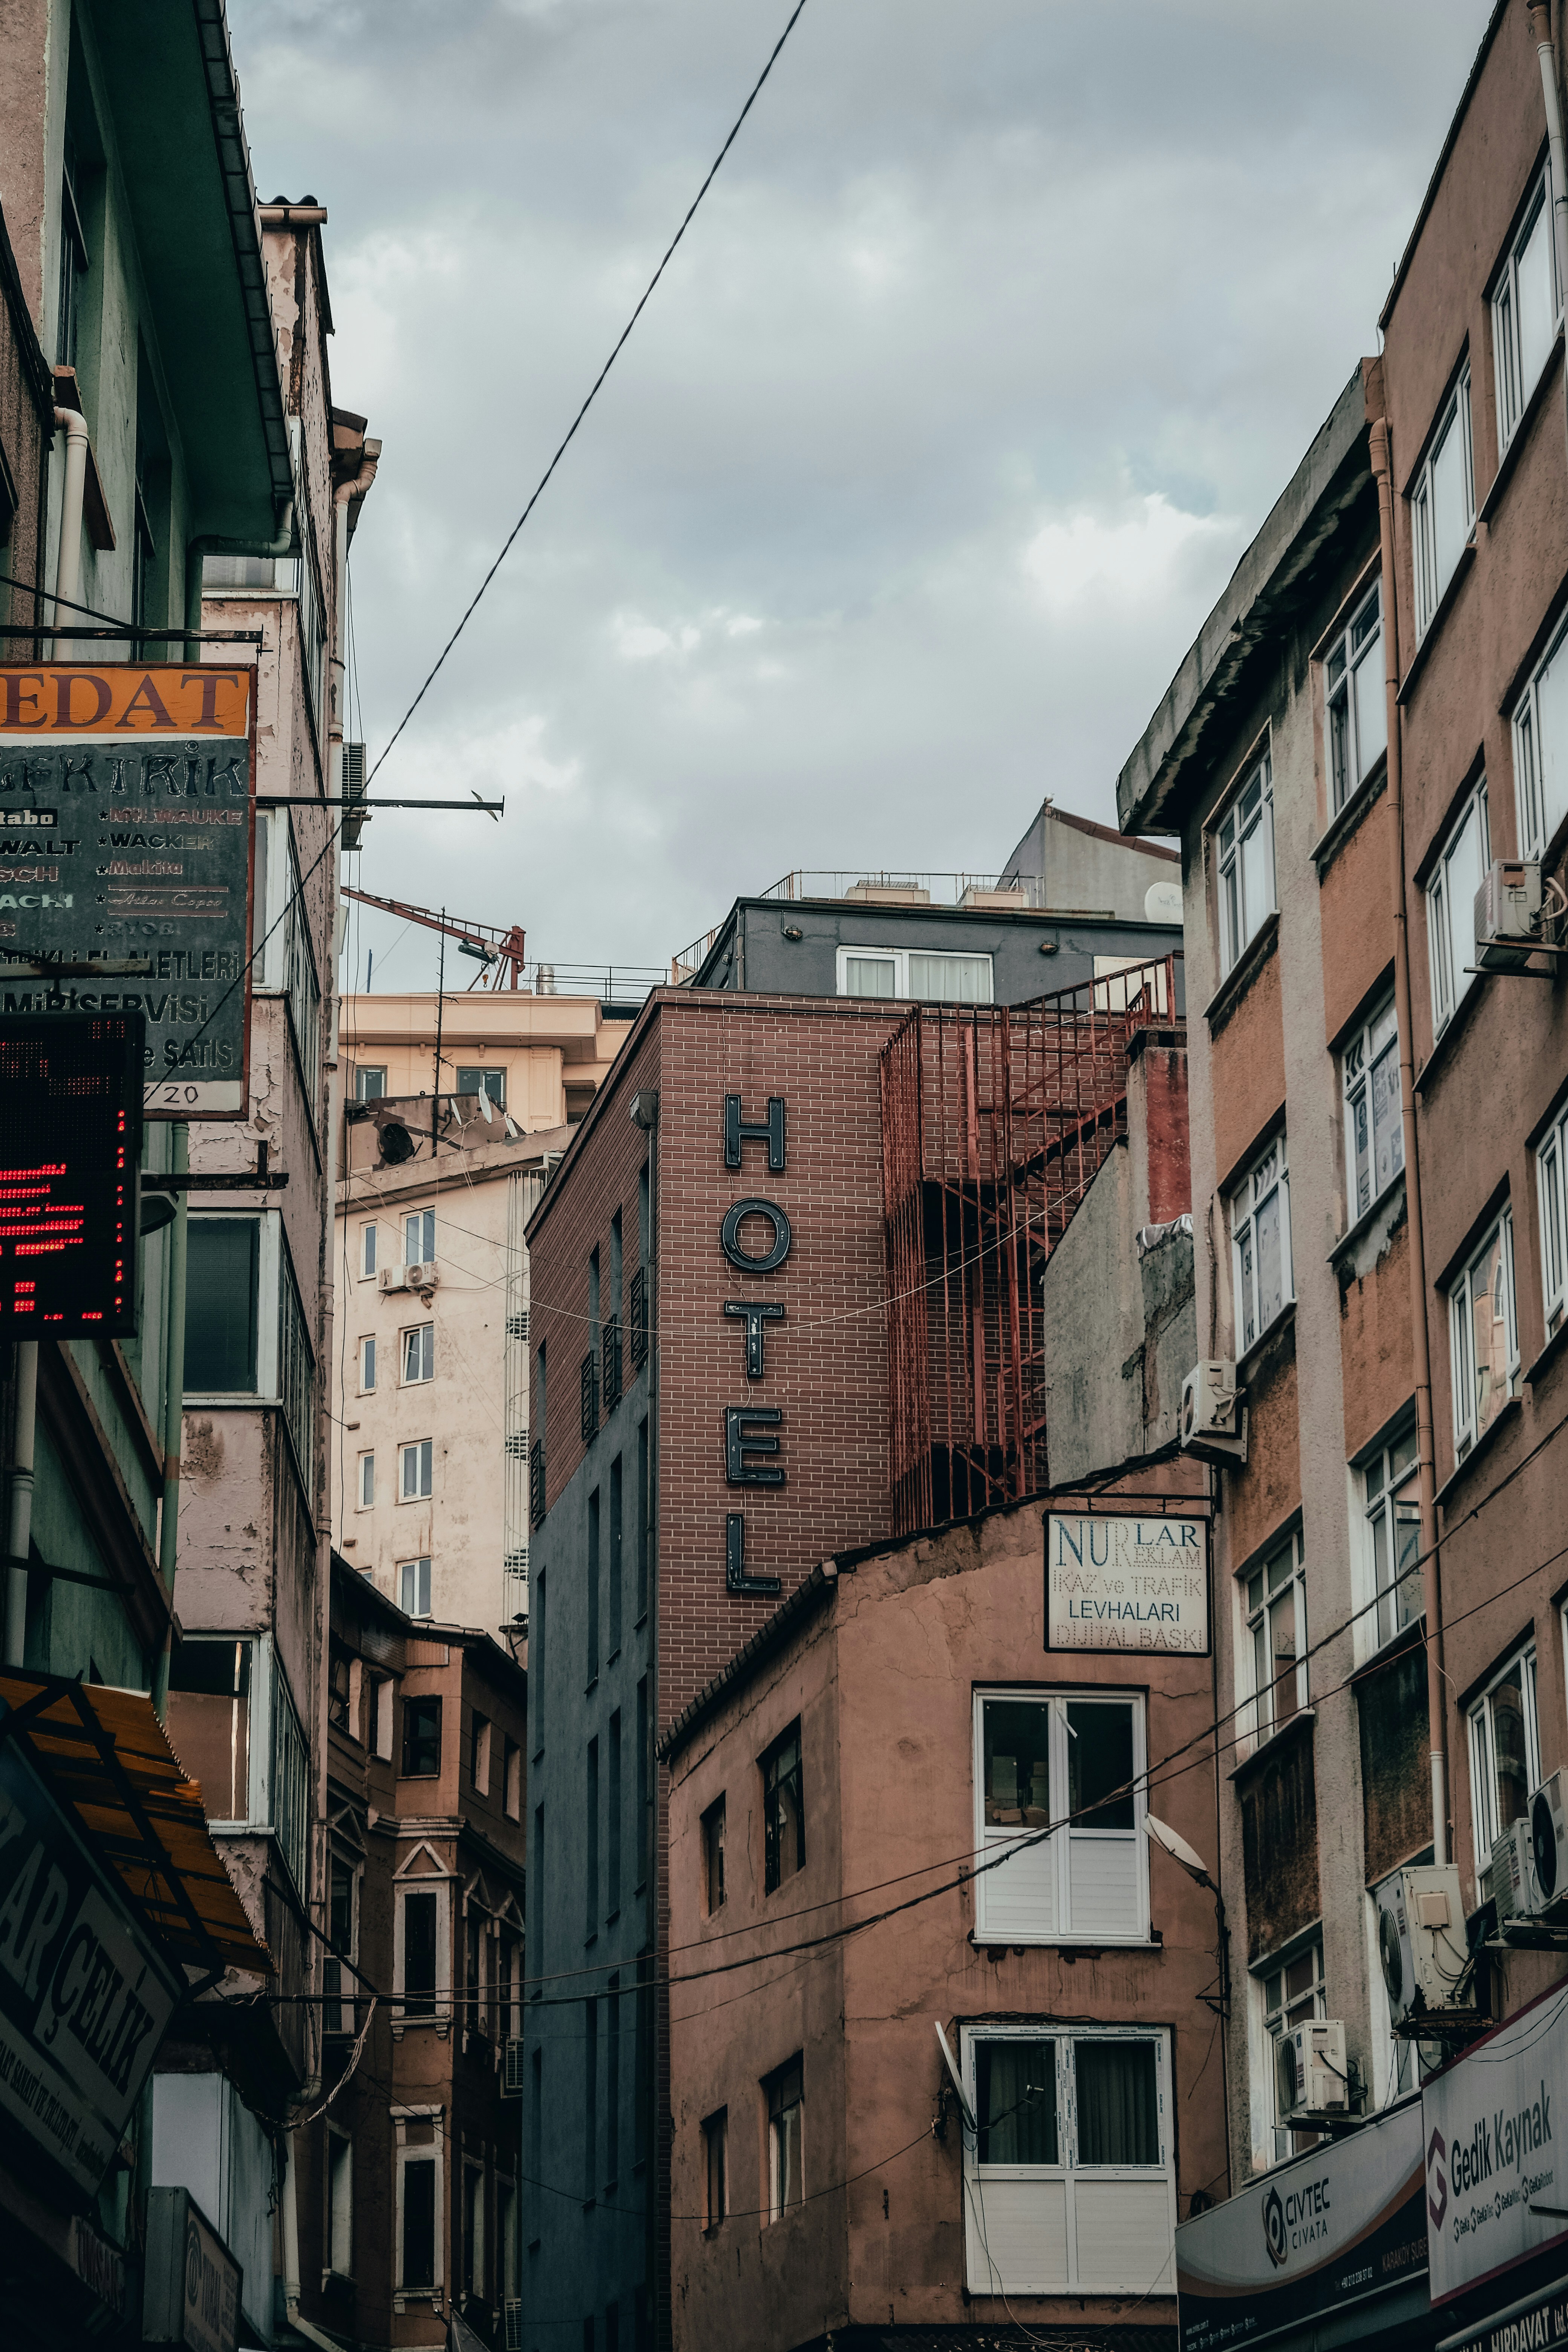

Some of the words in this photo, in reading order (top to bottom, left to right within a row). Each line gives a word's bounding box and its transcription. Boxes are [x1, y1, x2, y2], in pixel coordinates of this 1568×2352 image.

[109, 833, 216, 850] WACKER
[109, 860, 183, 875] Makita
[721, 1094, 792, 1594] HOTEL
[1103, 1579, 1125, 1594] ve
[1131, 1574, 1202, 1597] TRAFİK
[1069, 1600, 1180, 1622] LEVHALARI
[1140, 1627, 1202, 1649] BASKI
[1451, 2117, 1492, 2197] Gedik
[1494, 2079, 1552, 2174] Kaynak
[1286, 2177, 1331, 2226] CIVTEC
[1292, 2219, 1328, 2249] CIVATA
